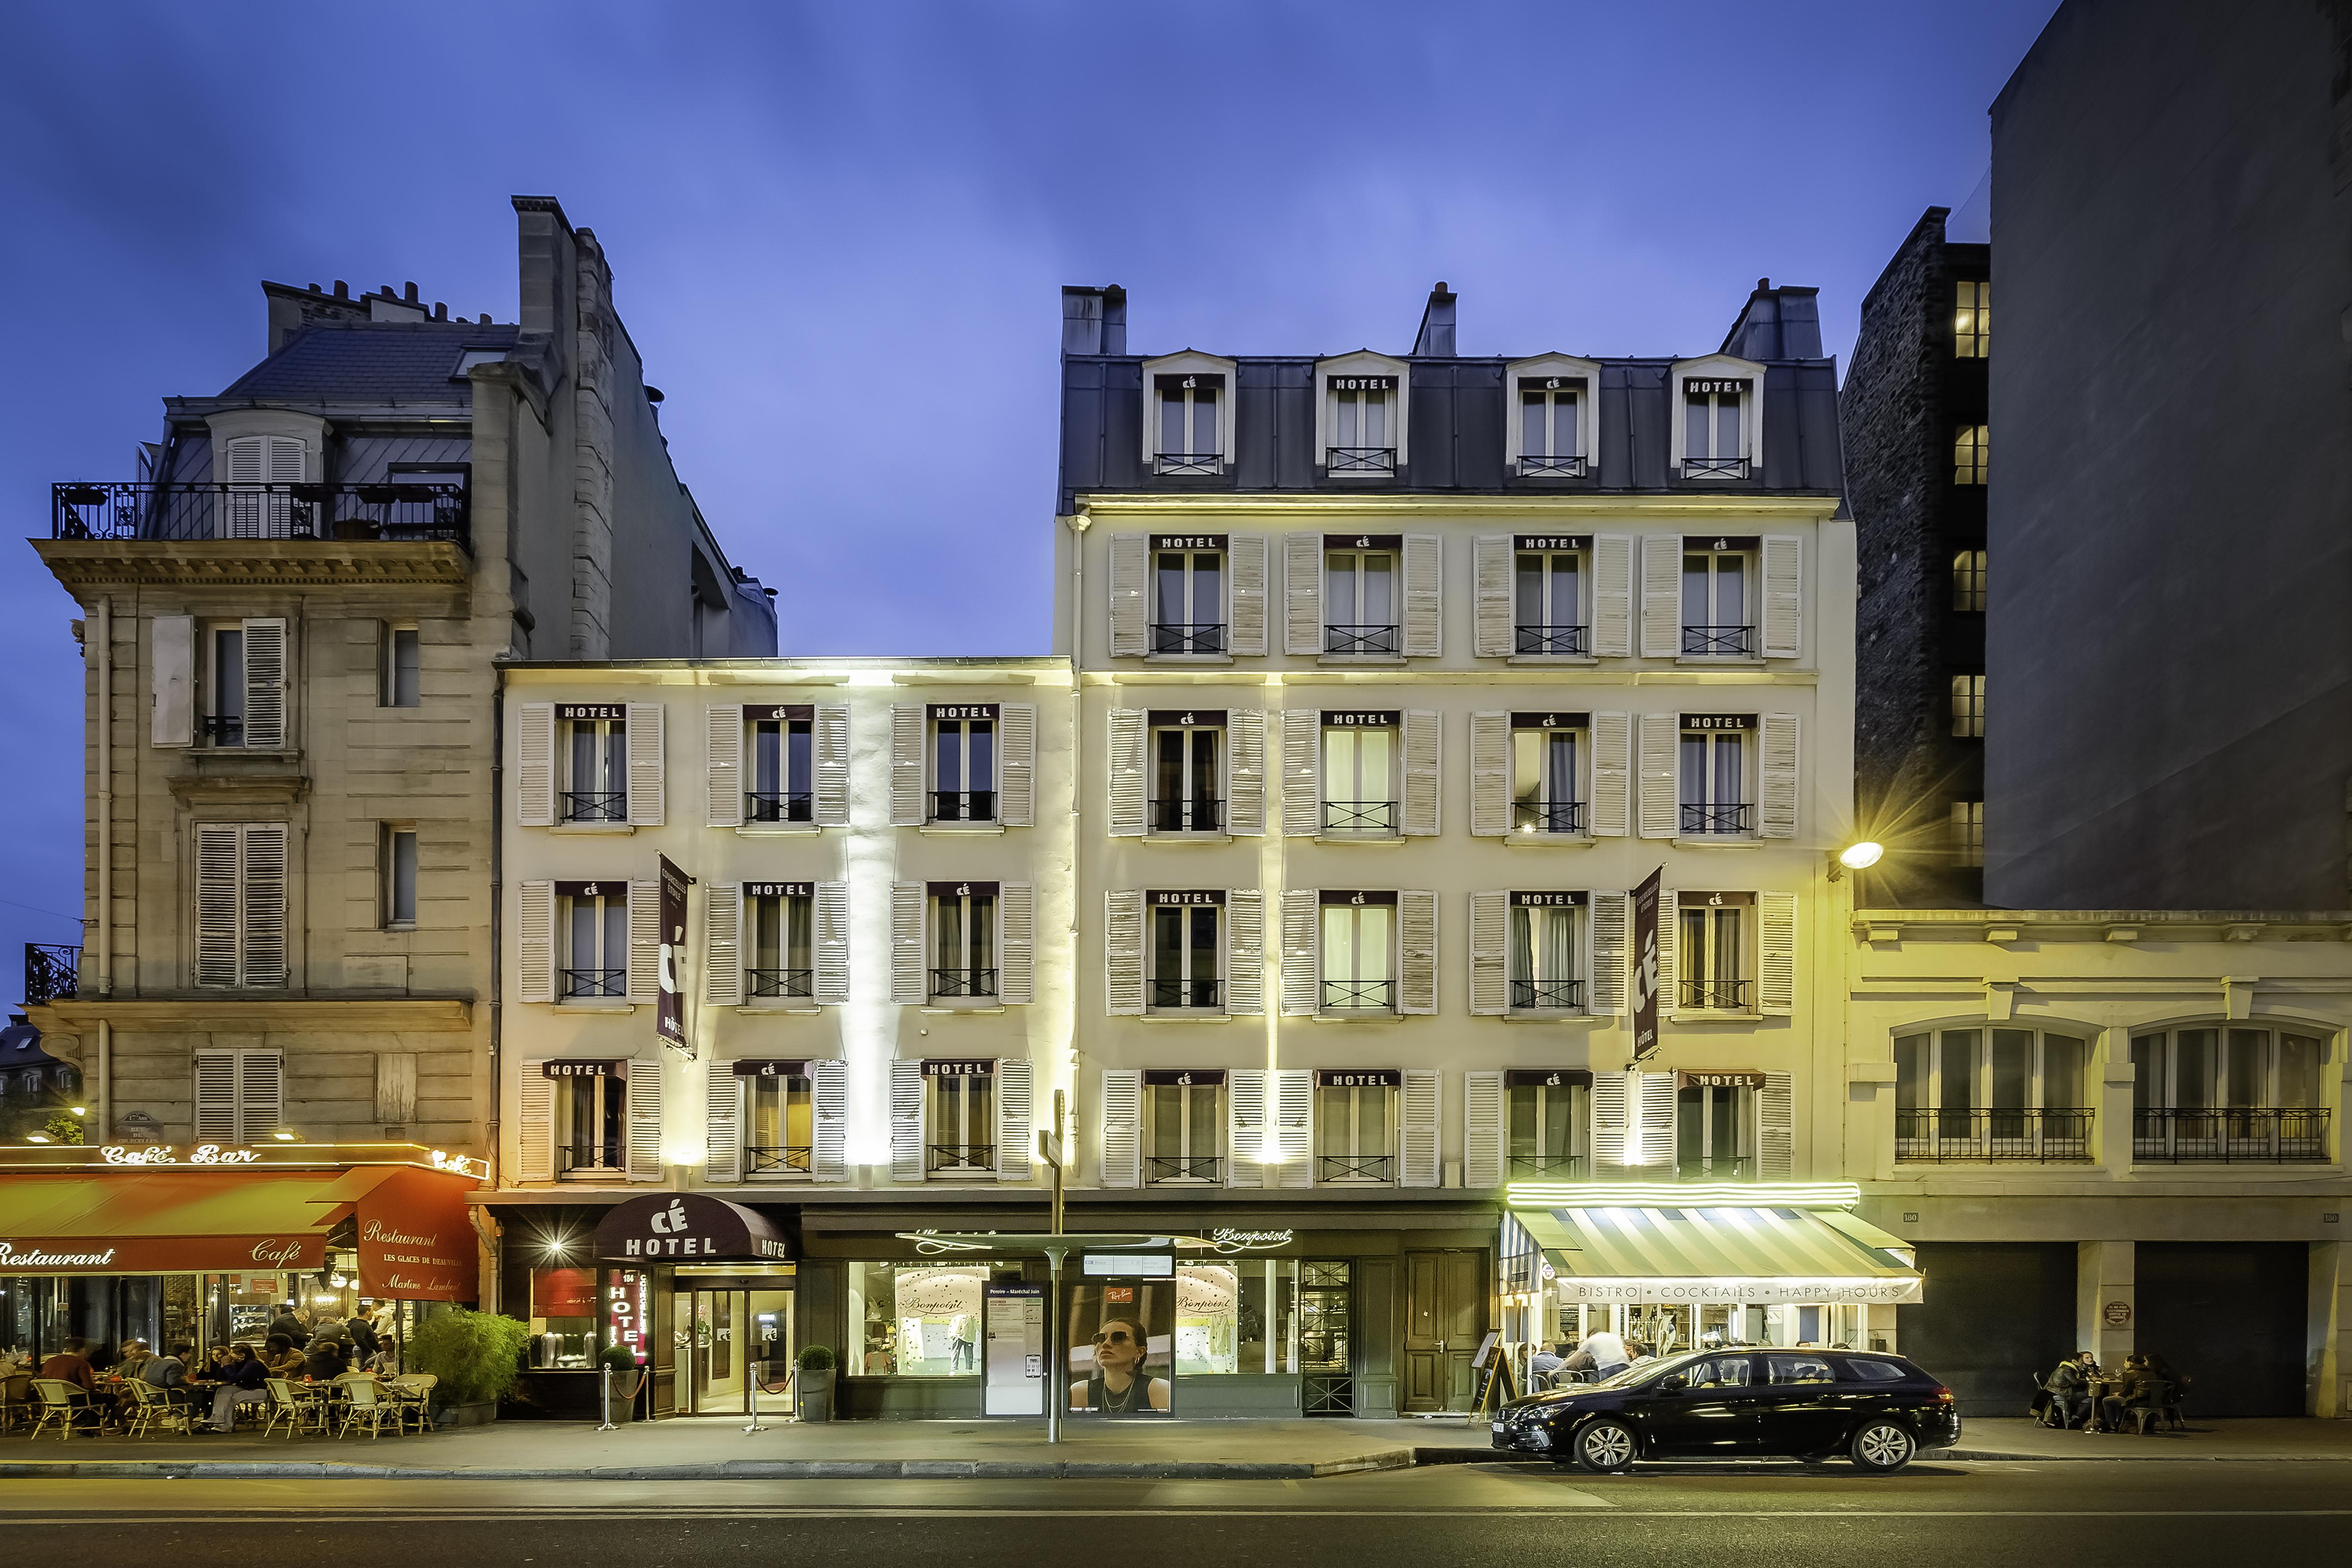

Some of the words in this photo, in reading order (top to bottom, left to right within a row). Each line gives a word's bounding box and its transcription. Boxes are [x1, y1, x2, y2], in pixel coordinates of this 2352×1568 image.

[1182, 375, 1196, 388] CÉ
[1336, 379, 1389, 389] HOTEL
[1546, 377, 1560, 389] CÉ
[1690, 382, 1743, 393] HOTEL
[1162, 538, 1217, 548] HOTEL
[1356, 536, 1370, 547] CÉ
[1526, 539, 1578, 548] HOTEL
[1714, 538, 1727, 550] CÉ
[565, 707, 619, 717] HOTEL
[772, 706, 786, 719] CÉ
[936, 707, 990, 717] HOTEL
[1180, 712, 1194, 724] CÉ
[1334, 715, 1387, 724] HOTEL
[1543, 714, 1556, 726] CÉ
[1691, 718, 1744, 727] HOTEL
[662, 868, 686, 894] COURCELLES
[584, 882, 598, 896] CÉ
[752, 885, 806, 895] HOTEL
[956, 883, 970, 896] CÉ
[1637, 880, 1659, 906] COURCELLES
[1159, 894, 1213, 903] HOTEL
[1351, 892, 1365, 904] CÉ
[1522, 895, 1576, 905] HOTEL
[1709, 893, 1723, 905] CÉ
[1634, 929, 1659, 1013] CÉ
[1637, 1029, 1653, 1047] HÔTEL
[550, 1065, 605, 1075] HOTEL
[761, 1063, 776, 1075] CÉ
[929, 1064, 984, 1074] HOTEL
[1177, 1072, 1192, 1085] CÉ
[1333, 1075, 1388, 1086] HOTEL
[1547, 1073, 1560, 1086] CÉ
[1700, 1075, 1754, 1086] HOTEL
[101, 1145, 176, 1164] Café
[190, 1144, 261, 1163] Bar
[432, 1150, 472, 1174] Café
[651, 1198, 688, 1233] CÉ
[1904, 1213, 1917, 1221] 180
[363, 1219, 437, 1247] Restaurant
[1212, 1228, 1293, 1249] Bonpoint
[626, 1238, 716, 1255] HOTEL
[762, 1239, 785, 1258] HOTEL
[0, 1242, 116, 1266] Restaurant
[249, 1239, 302, 1269] Café
[398, 1255, 420, 1263] GLACES
[432, 1258, 463, 1267] DEAUVILLE
[382, 1274, 421, 1290] Martine
[426, 1276, 461, 1291] Lambert
[1108, 1289, 1131, 1300] Ray-Ban
[1579, 1287, 1637, 1297] BISTRO
[1661, 1287, 1755, 1297] COCKTAILS
[1780, 1287, 1831, 1297] HAPPY
[1842, 1287, 1899, 1297] HOURS
[906, 1297, 963, 1313] Bonpoint
[1176, 1296, 1230, 1312] Bonpoint
[609, 1287, 646, 1356] HOTEL
[765, 1330, 776, 1341] CÉ
